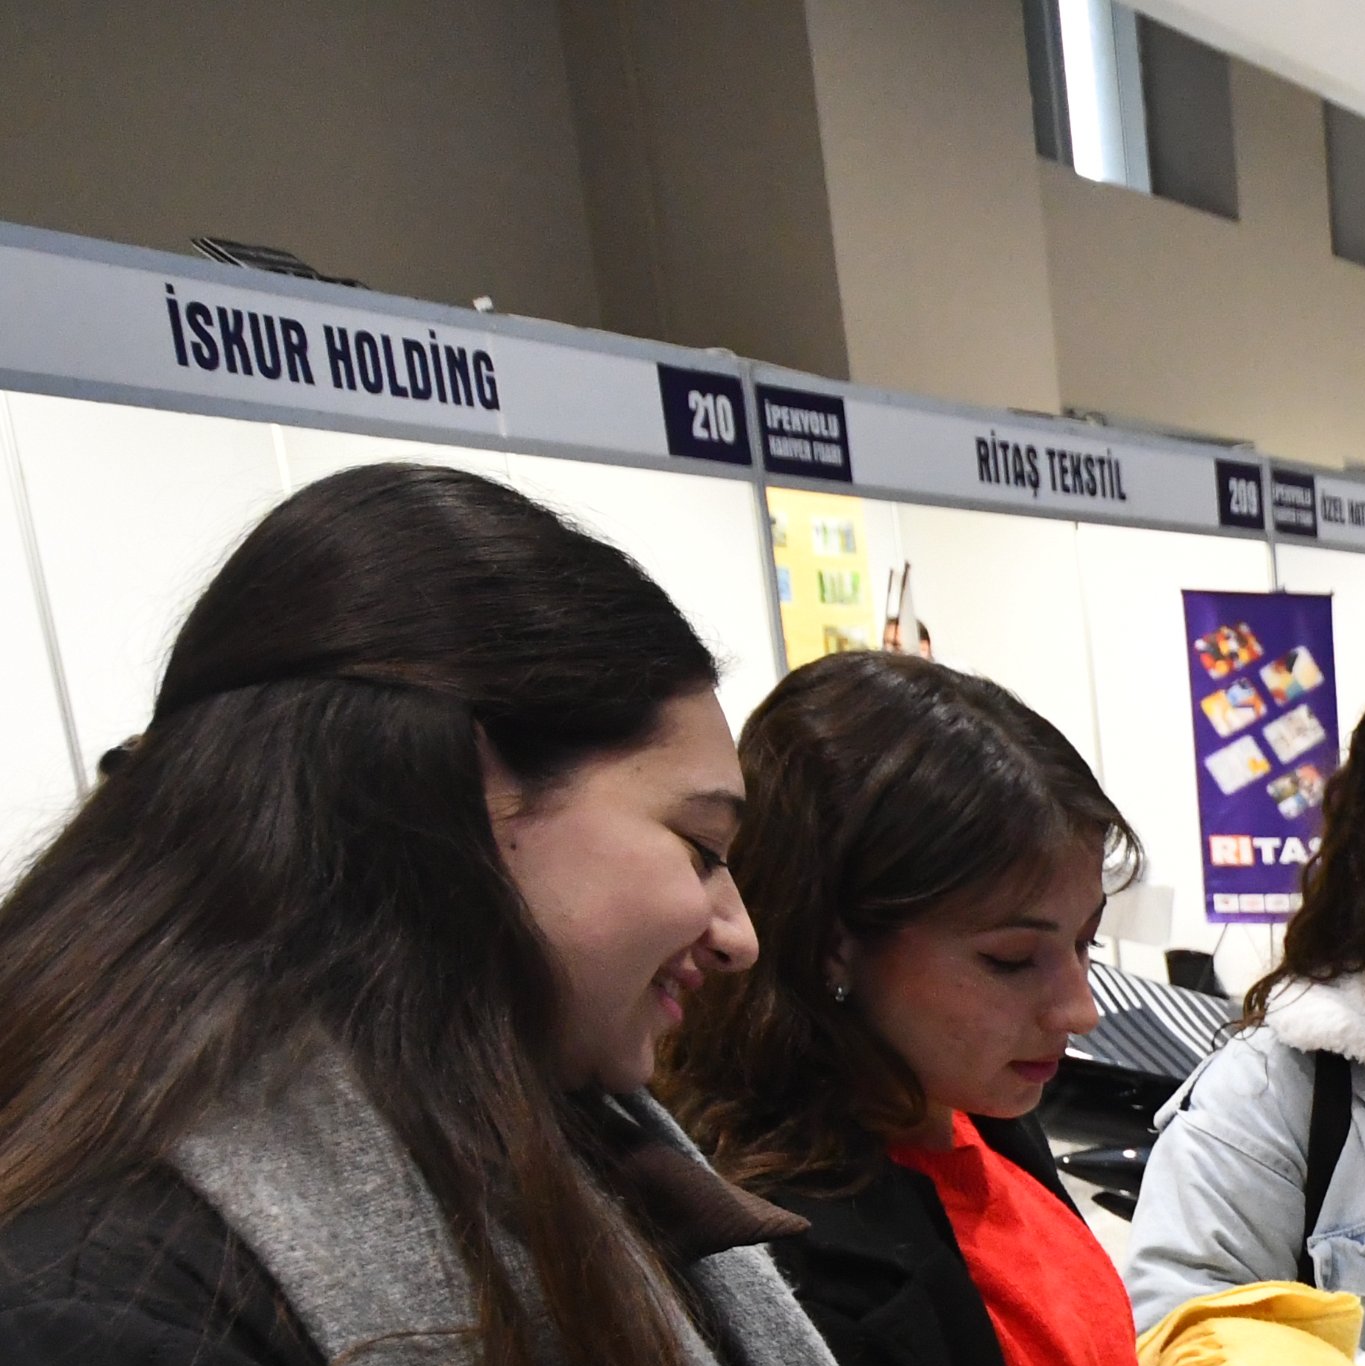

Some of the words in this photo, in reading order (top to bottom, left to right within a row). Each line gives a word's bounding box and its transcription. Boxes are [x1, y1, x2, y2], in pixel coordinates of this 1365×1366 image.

[166, 284, 314, 385] İSKUR
[323, 328, 500, 411] HOLDİNG
[688, 390, 735, 444] 210
[976, 430, 1040, 498] RİTAŞ
[1046, 448, 1127, 501] TEKSTİL
[1229, 478, 1257, 515] 209
